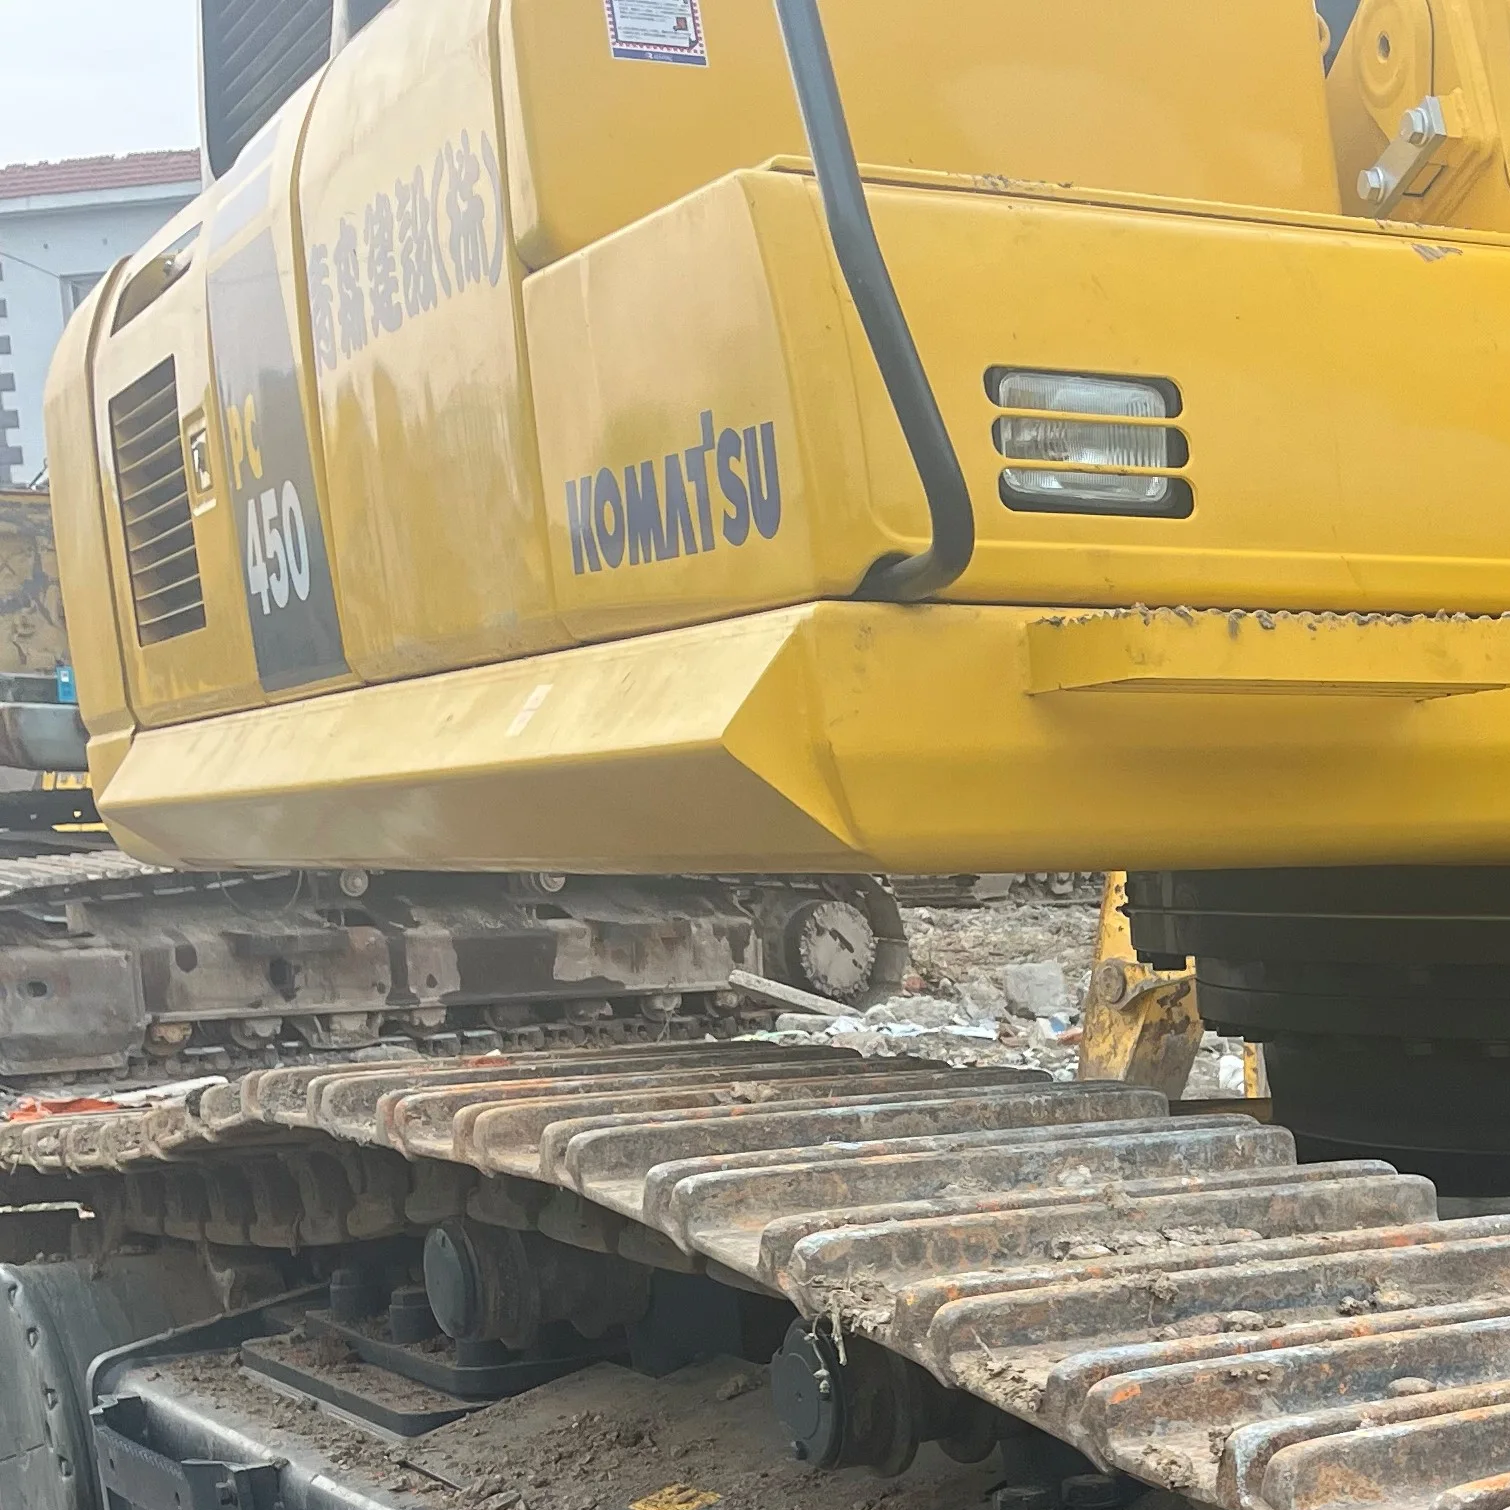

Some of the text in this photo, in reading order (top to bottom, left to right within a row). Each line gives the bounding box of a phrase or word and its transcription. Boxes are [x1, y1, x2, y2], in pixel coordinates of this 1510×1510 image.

[226, 392, 263, 491] PC
[565, 409, 781, 576] KOMATSU
[247, 479, 310, 616] 450
